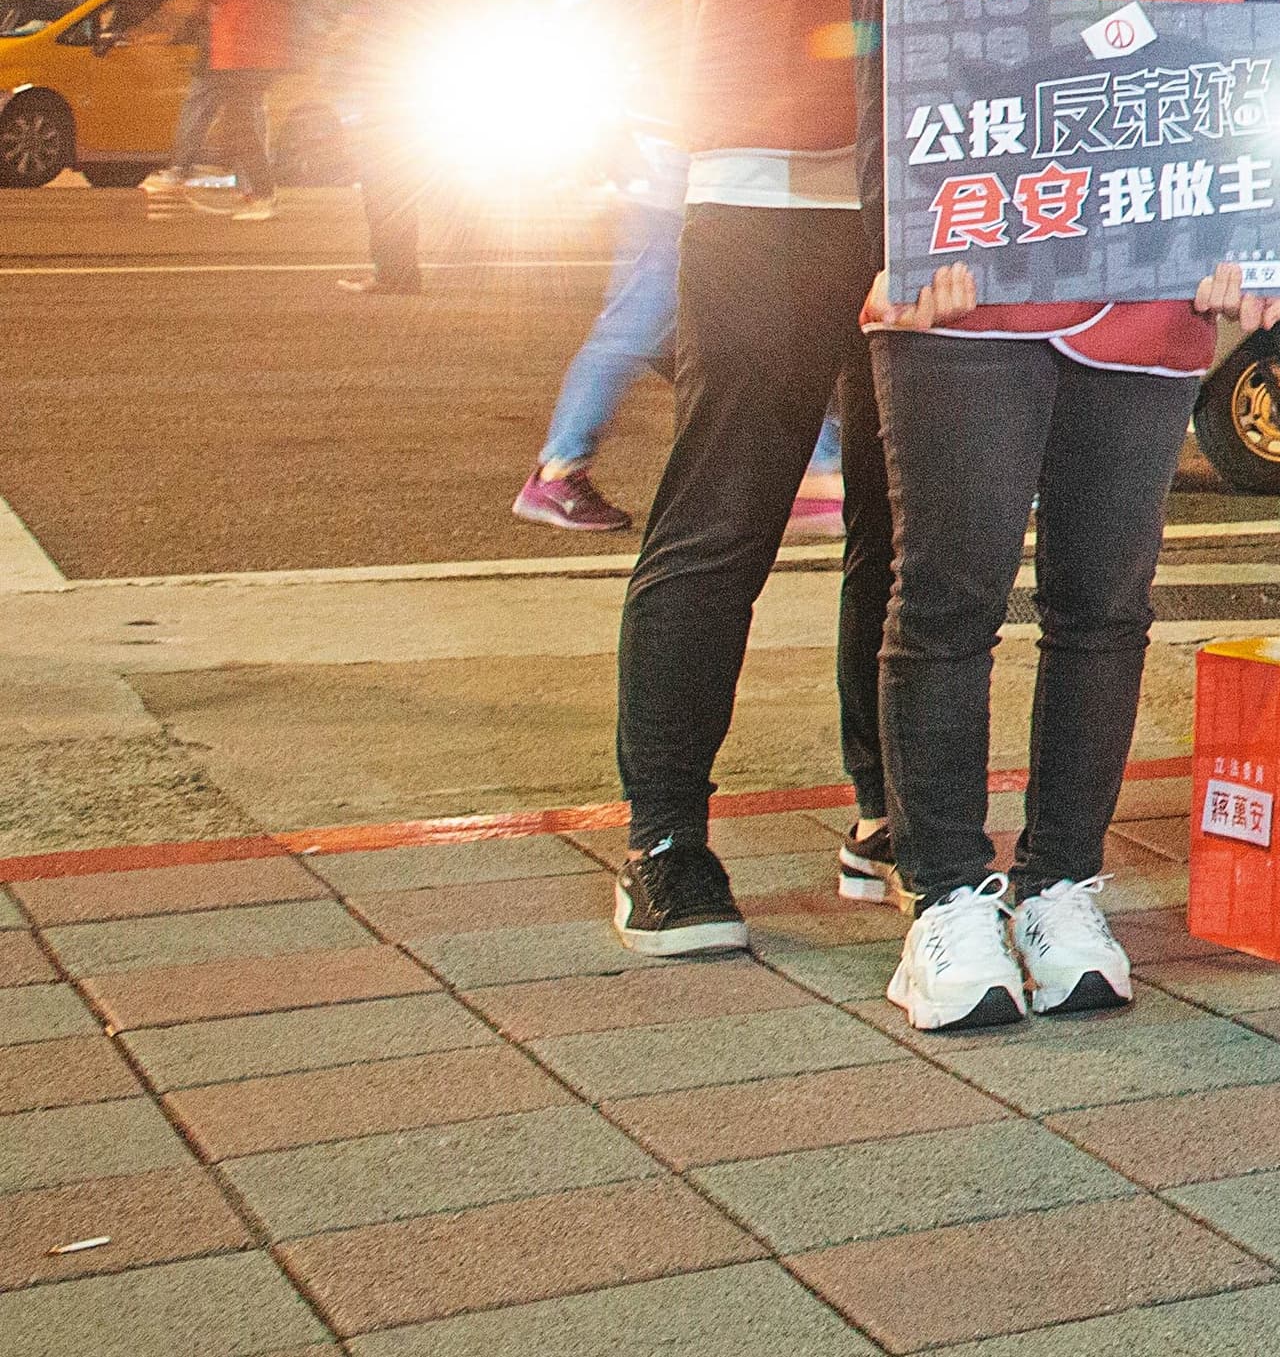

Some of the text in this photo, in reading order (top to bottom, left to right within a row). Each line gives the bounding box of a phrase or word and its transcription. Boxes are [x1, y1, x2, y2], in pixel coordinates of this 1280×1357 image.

[906, 57, 1272, 165] 公投反萊豬
[928, 156, 1274, 254] 食安我做主
[1211, 790, 1264, 833] 蔣萬安
